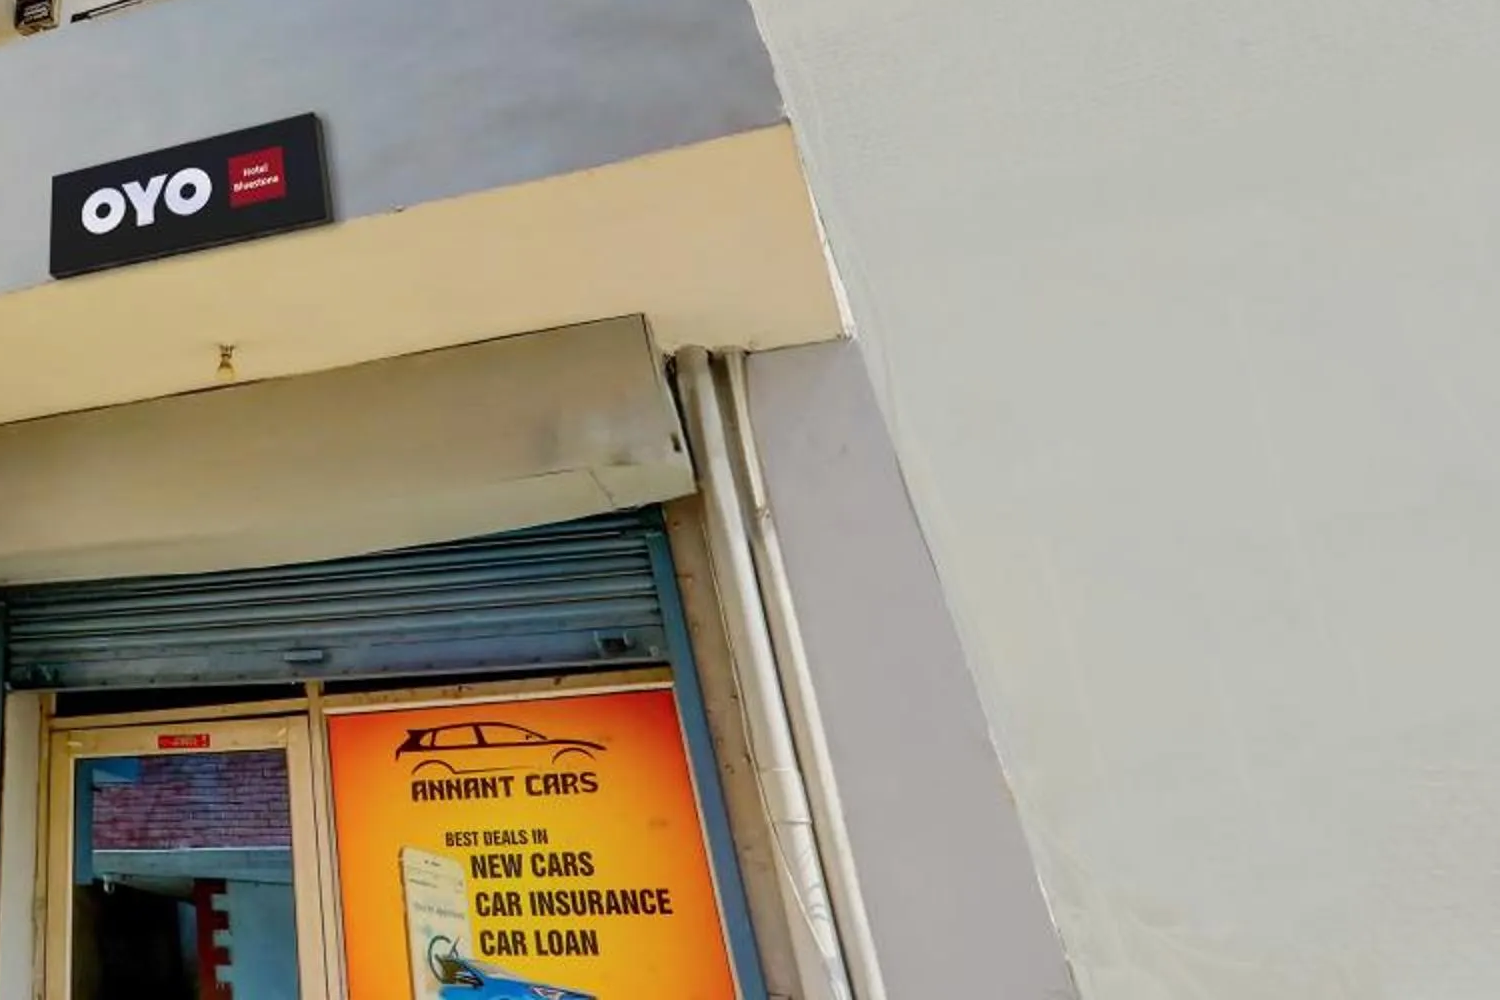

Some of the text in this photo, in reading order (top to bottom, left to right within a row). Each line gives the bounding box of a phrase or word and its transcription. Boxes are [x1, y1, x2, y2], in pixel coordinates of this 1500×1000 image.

[243, 162, 269, 177] Hotel
[81, 167, 213, 235] OYO
[411, 772, 598, 802] ANNANT CARS
[445, 828, 548, 847] BEST DEALS IN
[470, 851, 595, 878] NEW CARS
[475, 891, 523, 917] CAR
[530, 888, 673, 916] INSURANCE
[479, 930, 600, 956] CAR LOAN
